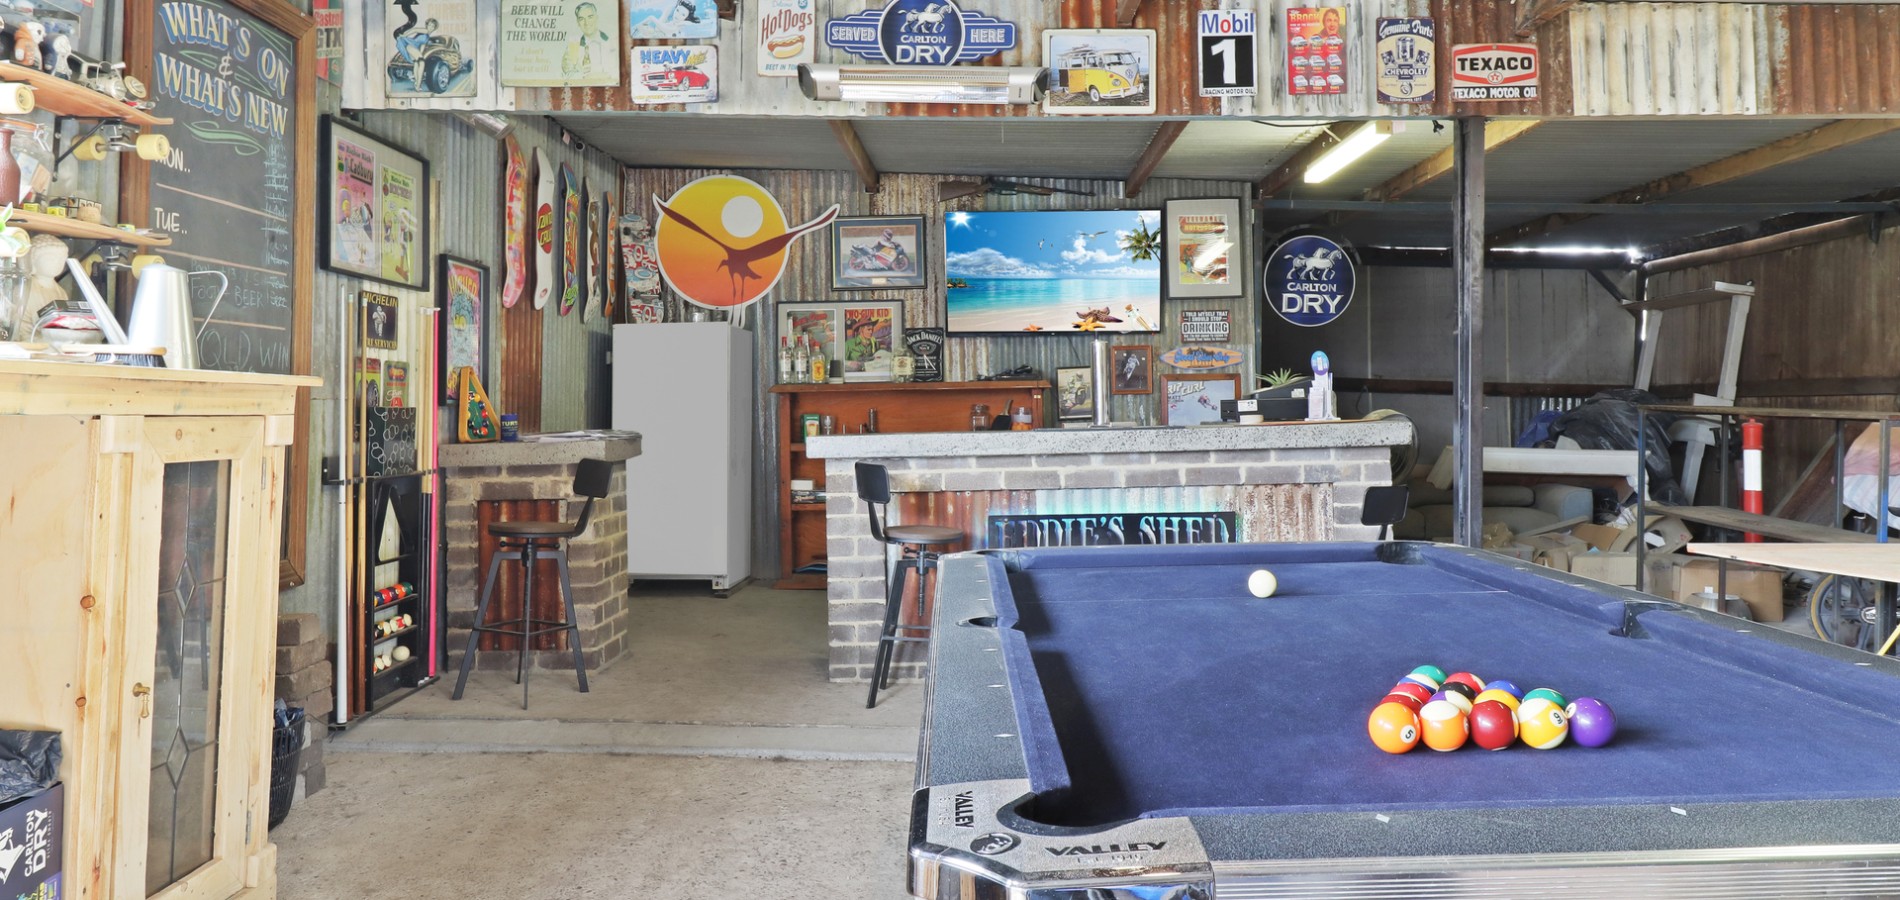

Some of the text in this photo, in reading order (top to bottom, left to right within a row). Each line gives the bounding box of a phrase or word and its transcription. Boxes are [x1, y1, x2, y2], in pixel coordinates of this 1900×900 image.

[511, 5, 565, 17] BEER WILL
[1289, 13, 1320, 23] BROCK
[514, 18, 557, 29] CHANGE
[1202, 13, 1254, 34] Mobil
[1379, 19, 1434, 39] Genuine Parts
[316, 28, 343, 48] GTX
[506, 31, 567, 42] THE WORLD!
[832, 26, 877, 42] SERVED
[900, 34, 946, 44] CARLTON
[970, 28, 1005, 43] HERE
[159, 2, 290, 99] WHAT'S ON
[640, 49, 692, 65] HEAVY
[895, 45, 953, 64] DRY
[218, 51, 234, 80] &
[780, 63, 786, 71] IN
[1211, 38, 1237, 85] 1
[1457, 57, 1533, 71] TEXACO
[1385, 67, 1427, 76] CHEVROLET
[155, 52, 288, 139] WHAT'S NEW
[1454, 87, 1537, 99] TEXACO MOTOR OIL
[1286, 282, 1337, 292] CARLTON
[234, 285, 263, 308] BEER
[362, 291, 398, 307] MICHELIN
[1281, 293, 1345, 314] DRY
[876, 308, 889, 319] KID
[1183, 322, 1228, 333] DRINKING
[906, 331, 943, 345] JACK DANIEL'S
[200, 328, 289, 370] QLD WIN
[1167, 381, 1205, 396] RIP CURL
[994, 515, 1230, 547] EDDIE'S SHED
[1405, 729, 1413, 739] 5
[954, 790, 975, 829] VALLEY
[24, 809, 36, 877] CARLTON
[32, 808, 48, 874] DRY
[1045, 841, 1167, 856] VALLEY
